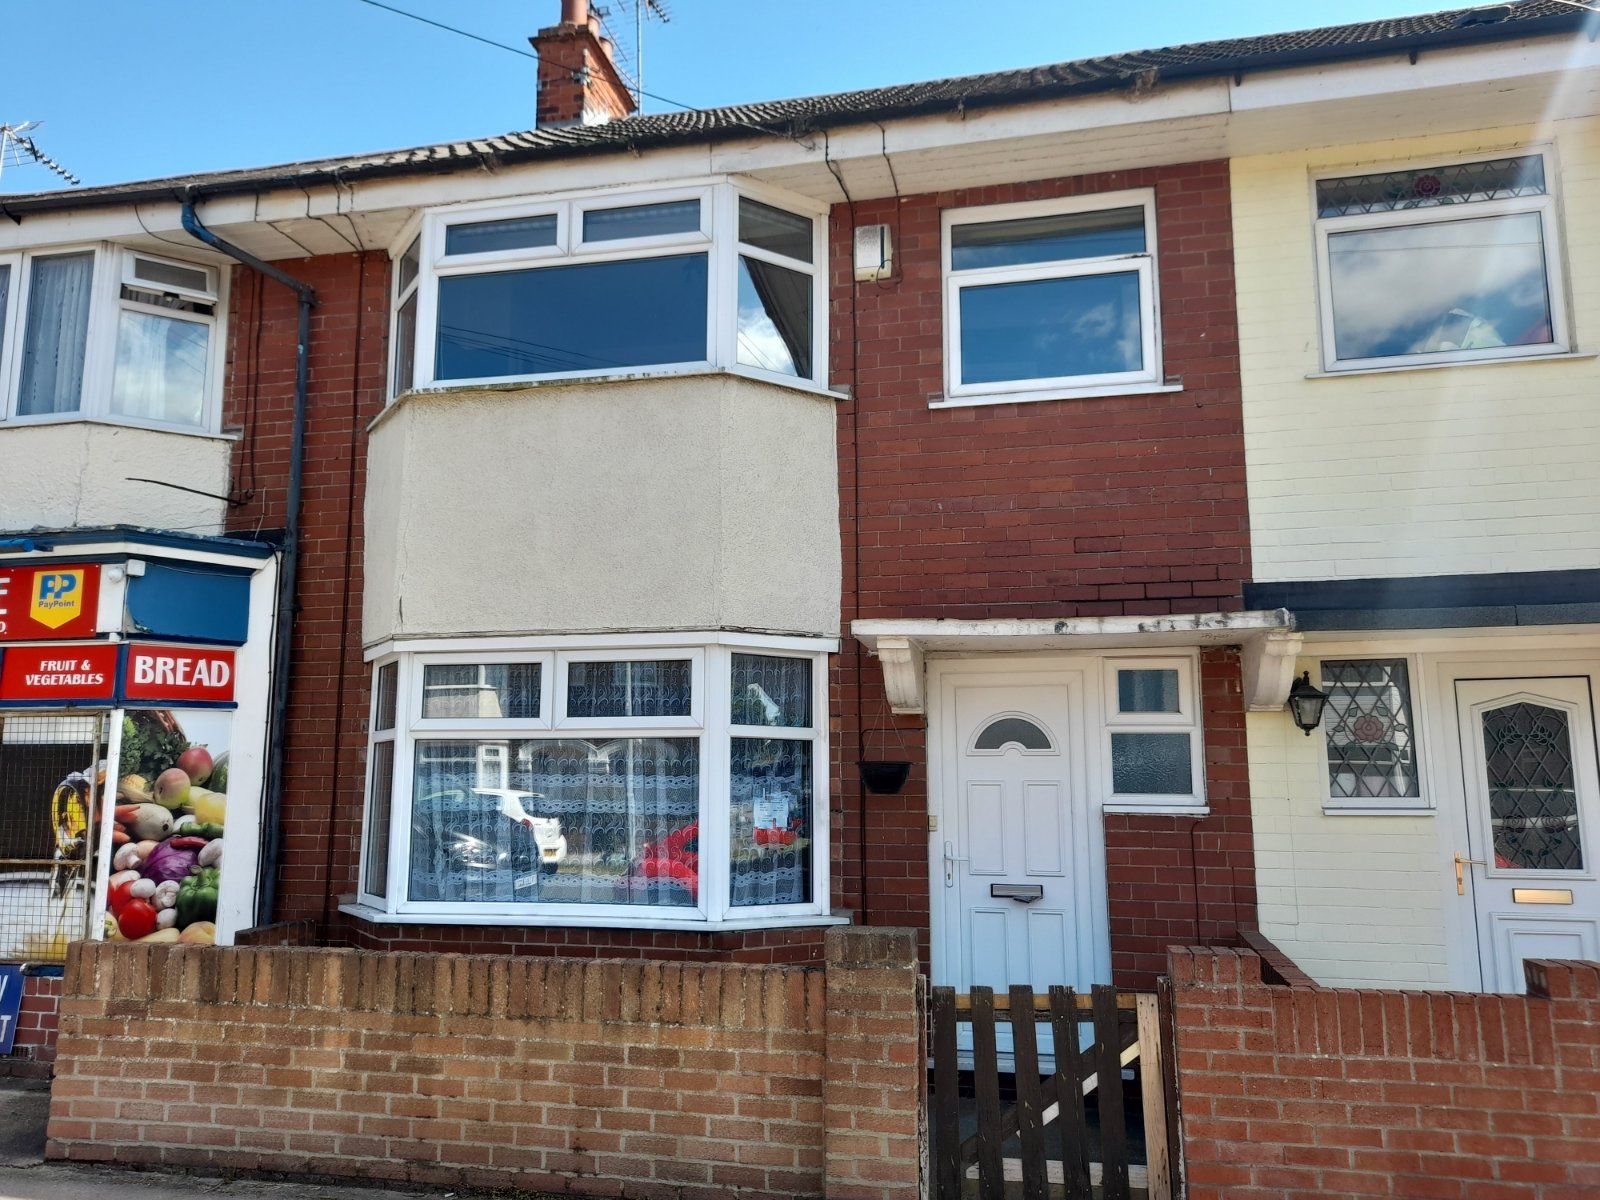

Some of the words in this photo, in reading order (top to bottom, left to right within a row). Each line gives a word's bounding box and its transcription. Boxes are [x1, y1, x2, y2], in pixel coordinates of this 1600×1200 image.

[38, 600, 75, 610] PayPoint
[40, 660, 77, 671] FRUIT
[81, 660, 91, 671] &
[134, 655, 230, 687] BREAD
[25, 673, 104, 685] VEGETABLES
